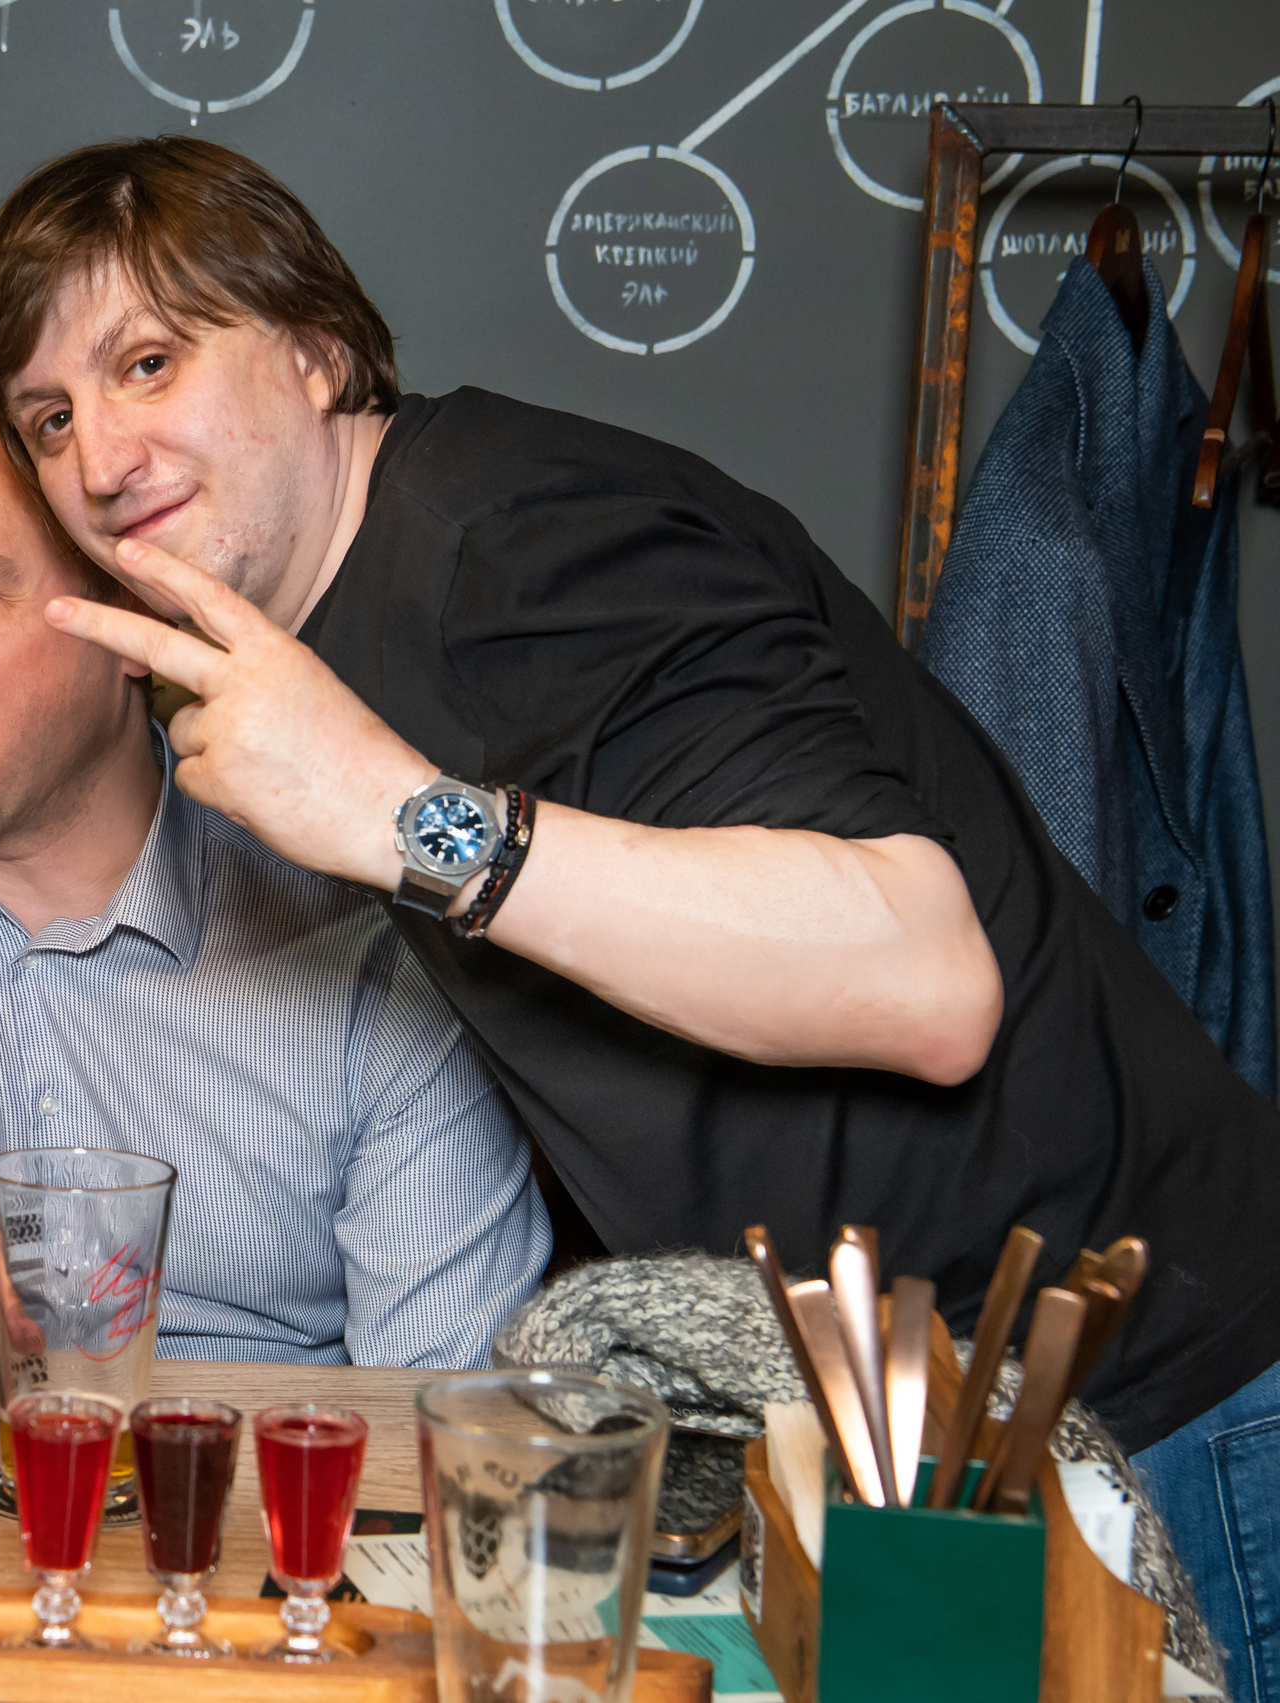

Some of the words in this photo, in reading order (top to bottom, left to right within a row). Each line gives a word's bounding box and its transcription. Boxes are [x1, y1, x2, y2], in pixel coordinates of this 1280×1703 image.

[179, 17, 240, 53] ЭЛЬ
[570, 203, 735, 234] АМЕРИКАНСКИЙ
[595, 239, 700, 267] КРЕПКИЙ
